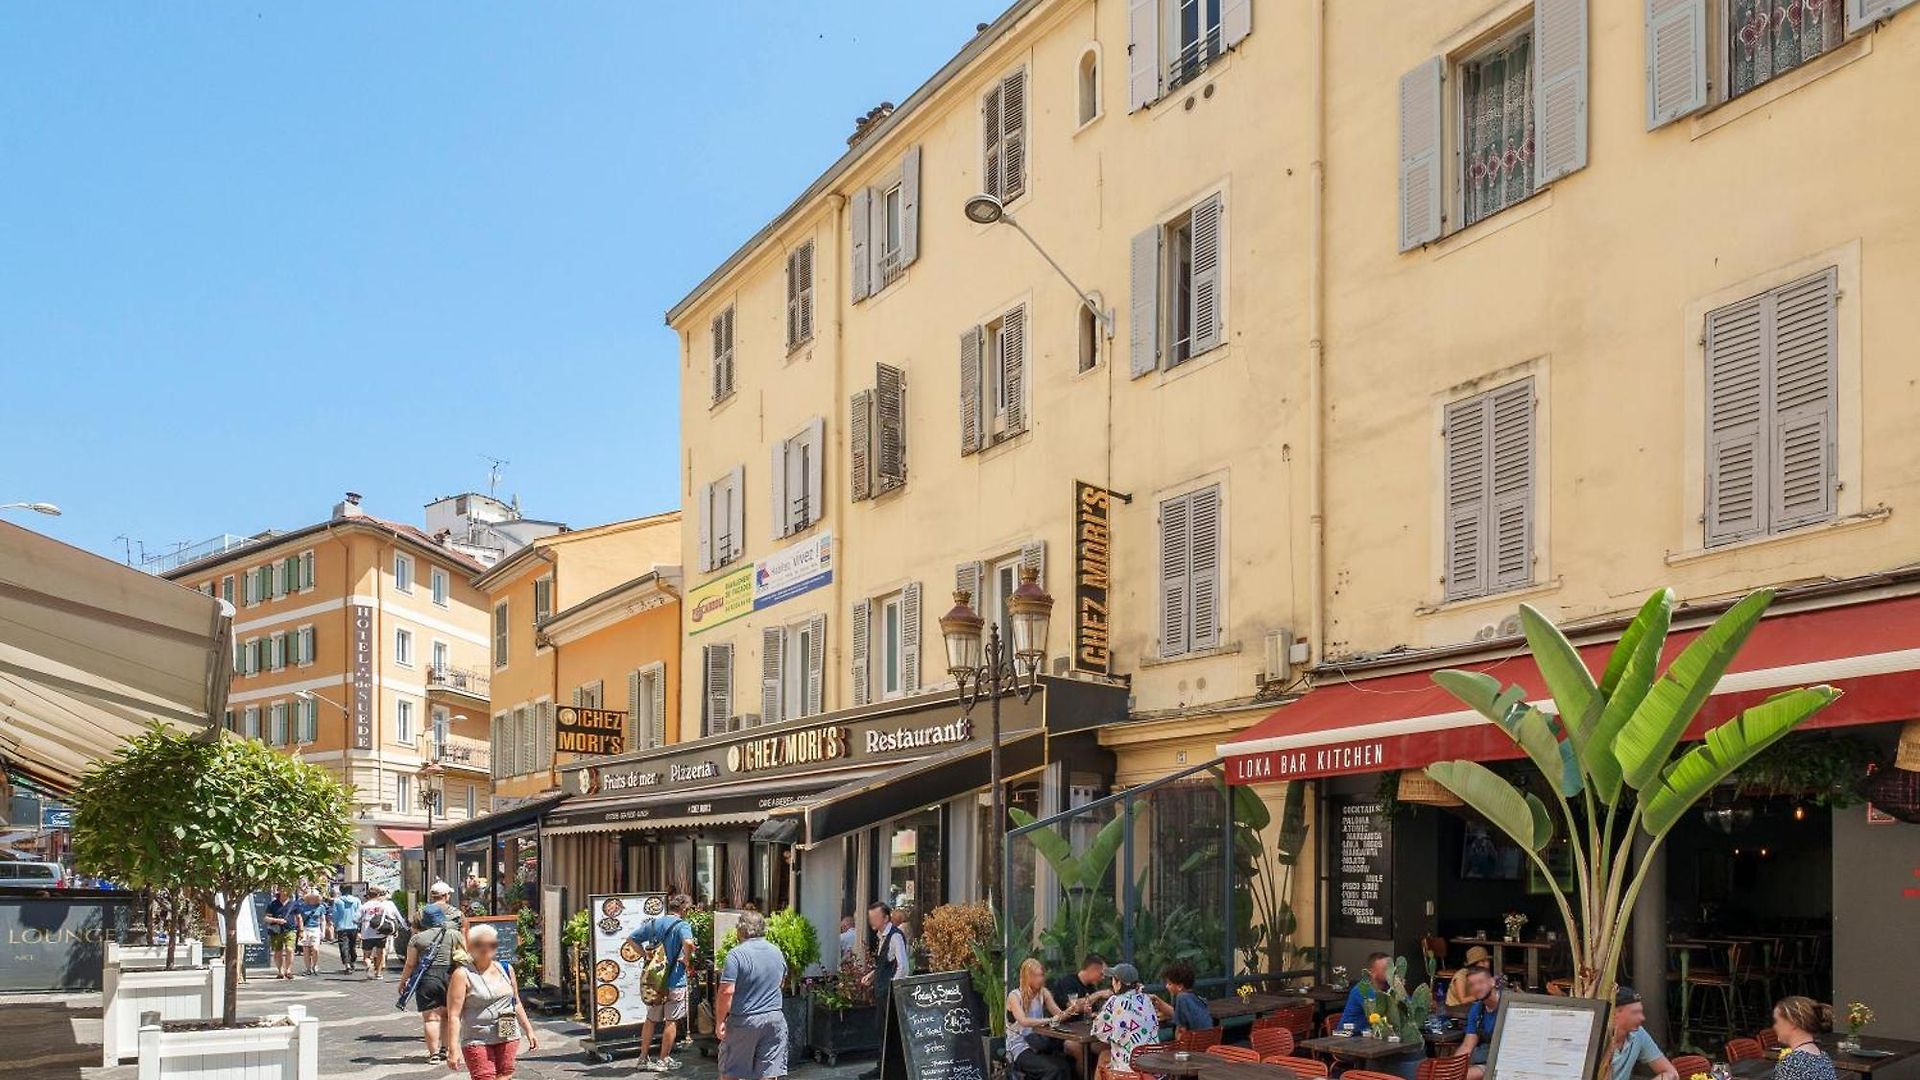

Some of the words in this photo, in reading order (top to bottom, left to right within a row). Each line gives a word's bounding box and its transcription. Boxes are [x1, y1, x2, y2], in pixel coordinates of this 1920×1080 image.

[1082, 486, 1107, 590] MORI'S
[356, 606, 369, 664] HOTEL
[1082, 596, 1107, 665] CHEZ
[357, 691, 369, 747] SUEDE
[582, 709, 622, 730] CHEZ
[866, 718, 967, 753] Restaurant
[559, 731, 622, 755] MORI'S
[745, 738, 778, 769] CHEZ
[785, 727, 839, 764] MORI'S
[670, 761, 712, 782] Pizzeria
[1239, 757, 1271, 779] LOKA
[1280, 753, 1306, 774] BAR
[1317, 744, 1383, 770] KITCHEN
[603, 773, 627, 791] Fruits
[639, 773, 656, 786] mer
[9, 928, 116, 945] LOUNGE
